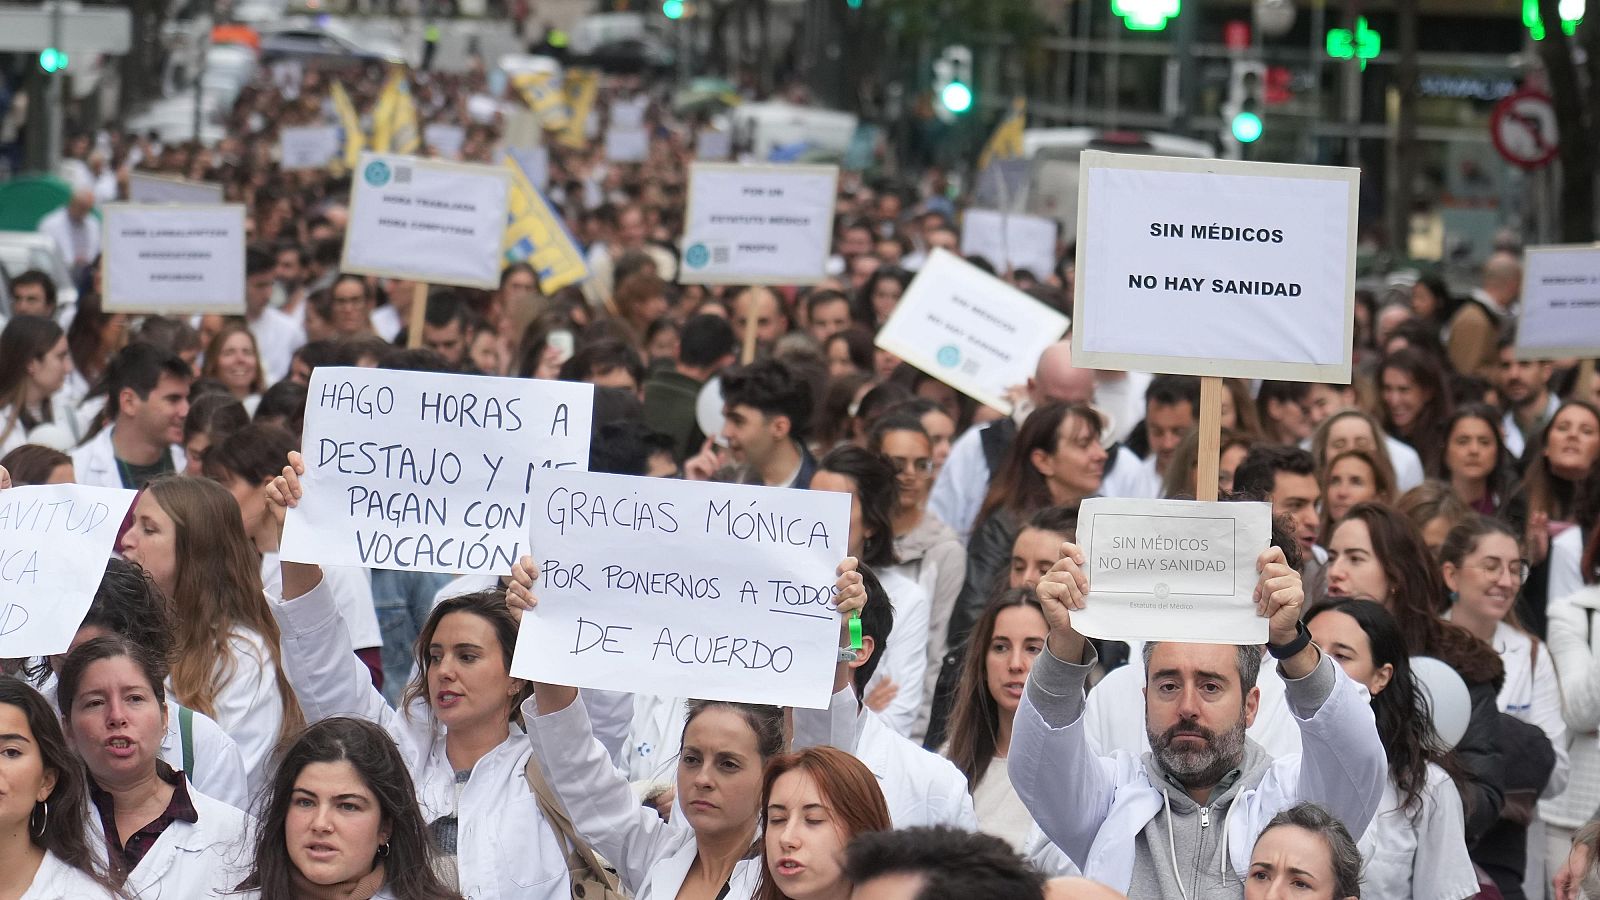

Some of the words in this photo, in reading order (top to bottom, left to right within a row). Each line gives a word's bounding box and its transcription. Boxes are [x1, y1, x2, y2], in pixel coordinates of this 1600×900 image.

[1149, 222, 1184, 238] SIN
[1191, 223, 1284, 243] MÉDICOS
[1128, 274, 1158, 290] NO
[1164, 276, 1206, 292] HAY
[1211, 278, 1302, 297] SANIDAD
[320, 381, 395, 420] HAGO
[420, 391, 523, 432] HORAS
[550, 403, 569, 437] A
[317, 438, 462, 486] DESTAJO
[482, 453, 504, 492] Y
[347, 486, 447, 528] PAGAN
[463, 501, 526, 530] CON
[706, 500, 829, 549] MÓNICA
[356, 531, 520, 571] VOCACIÓN
[1099, 557, 1122, 570] NO
[1126, 557, 1156, 570] HAY
[1160, 559, 1226, 572] SANIDAD
[1112, 536, 1136, 549] SIN
[1141, 534, 1210, 552] MÉDICOS
[541, 560, 592, 592] POR
[601, 565, 721, 600] PONERNOS
[738, 580, 759, 604] A
[569, 617, 633, 656] DE
[651, 627, 794, 673] ACUERDO
